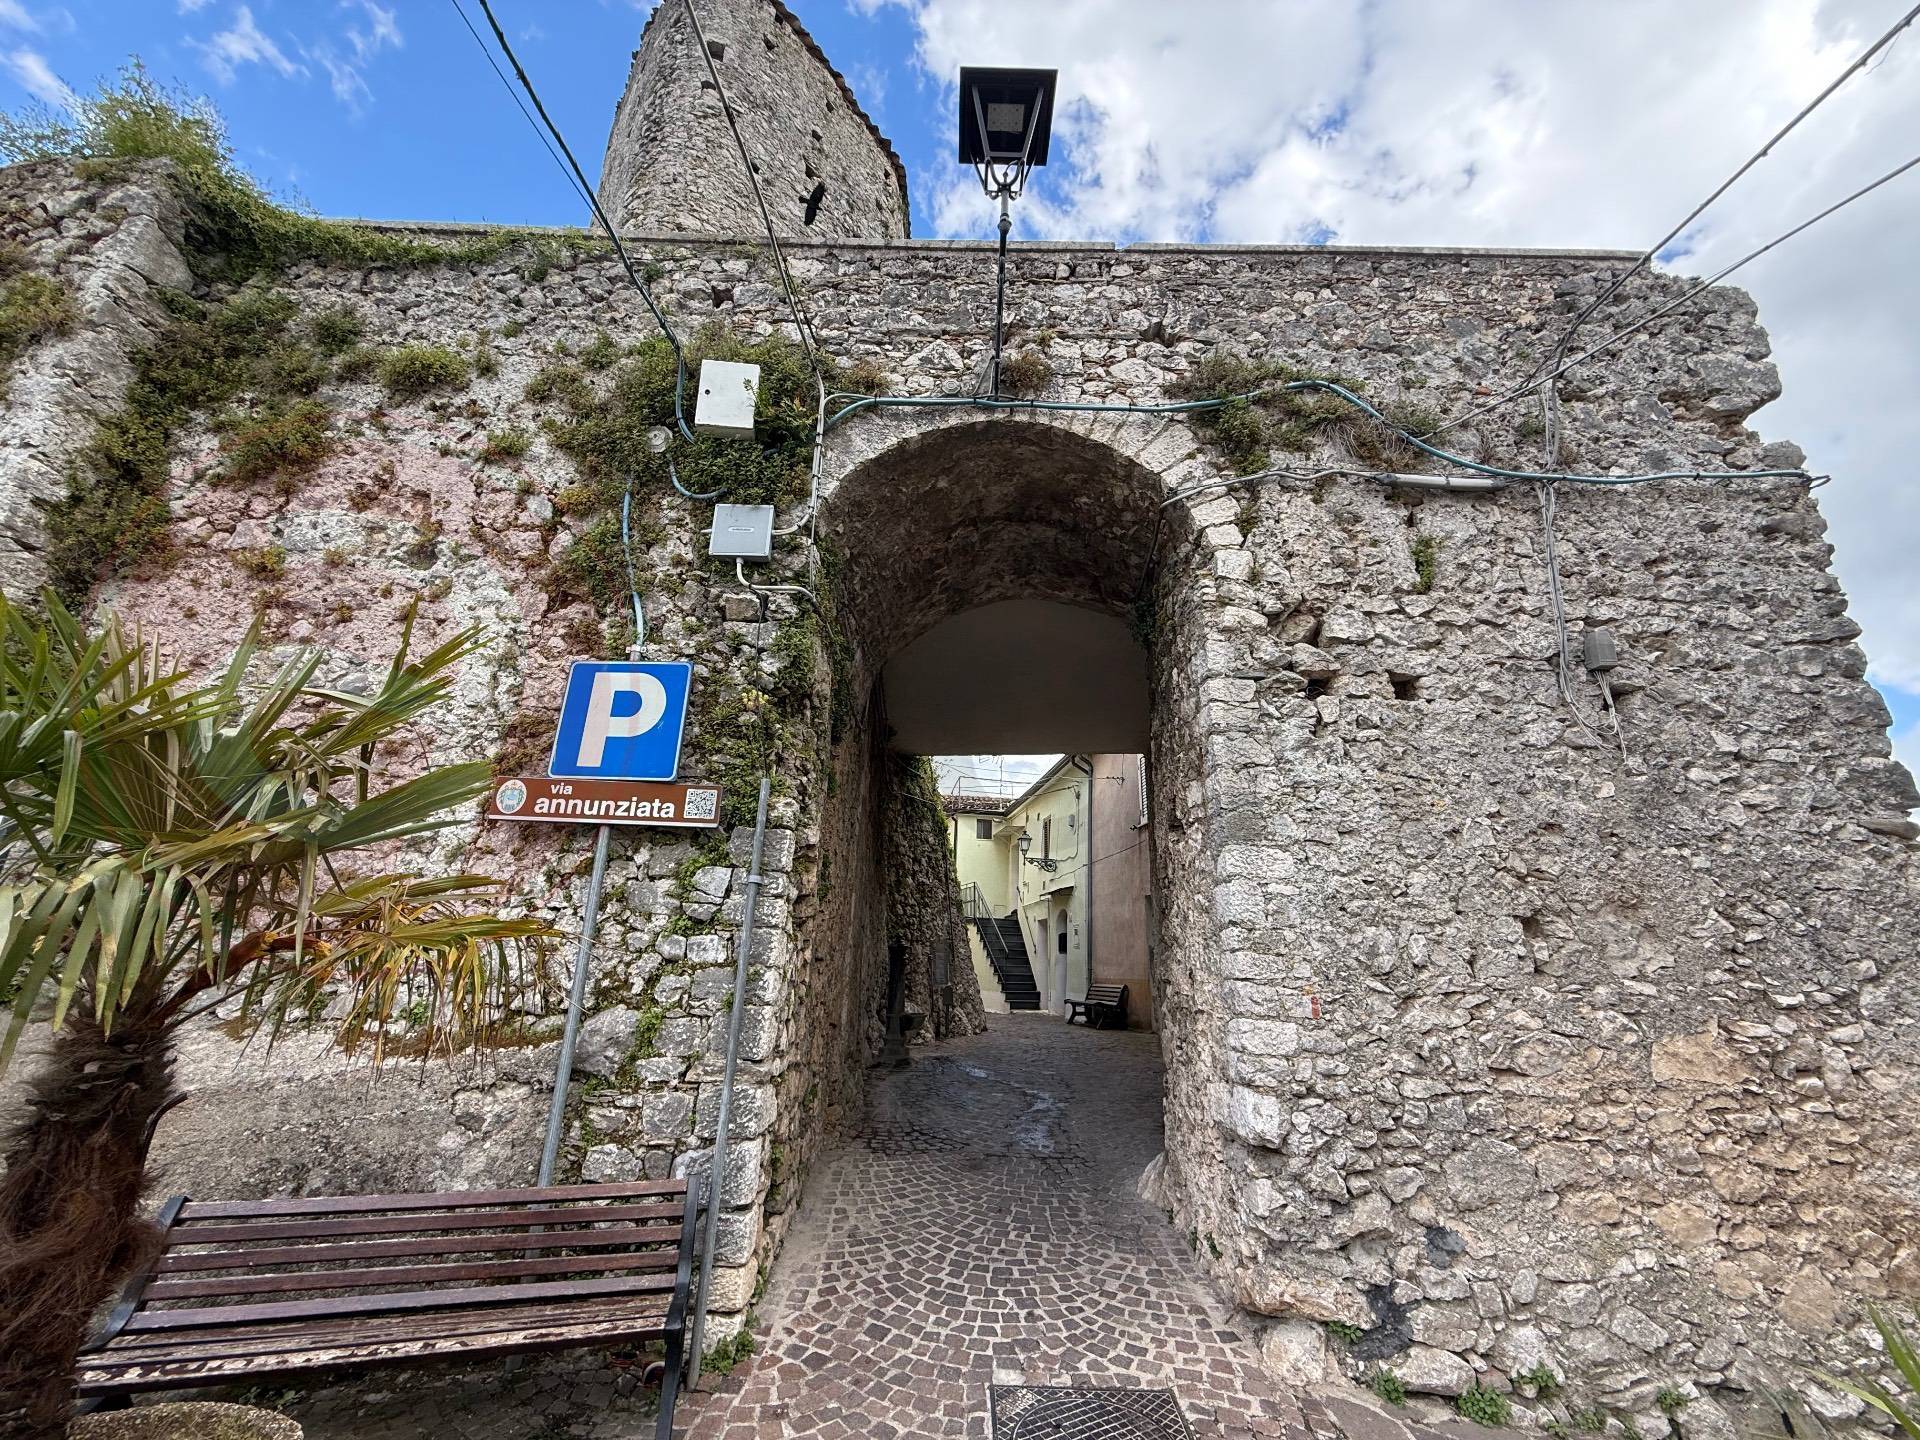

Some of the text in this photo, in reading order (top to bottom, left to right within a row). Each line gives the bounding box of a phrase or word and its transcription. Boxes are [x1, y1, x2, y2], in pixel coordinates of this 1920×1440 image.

[576, 671, 667, 768] P
[550, 782, 573, 795] via
[533, 796, 675, 818] annunziata
